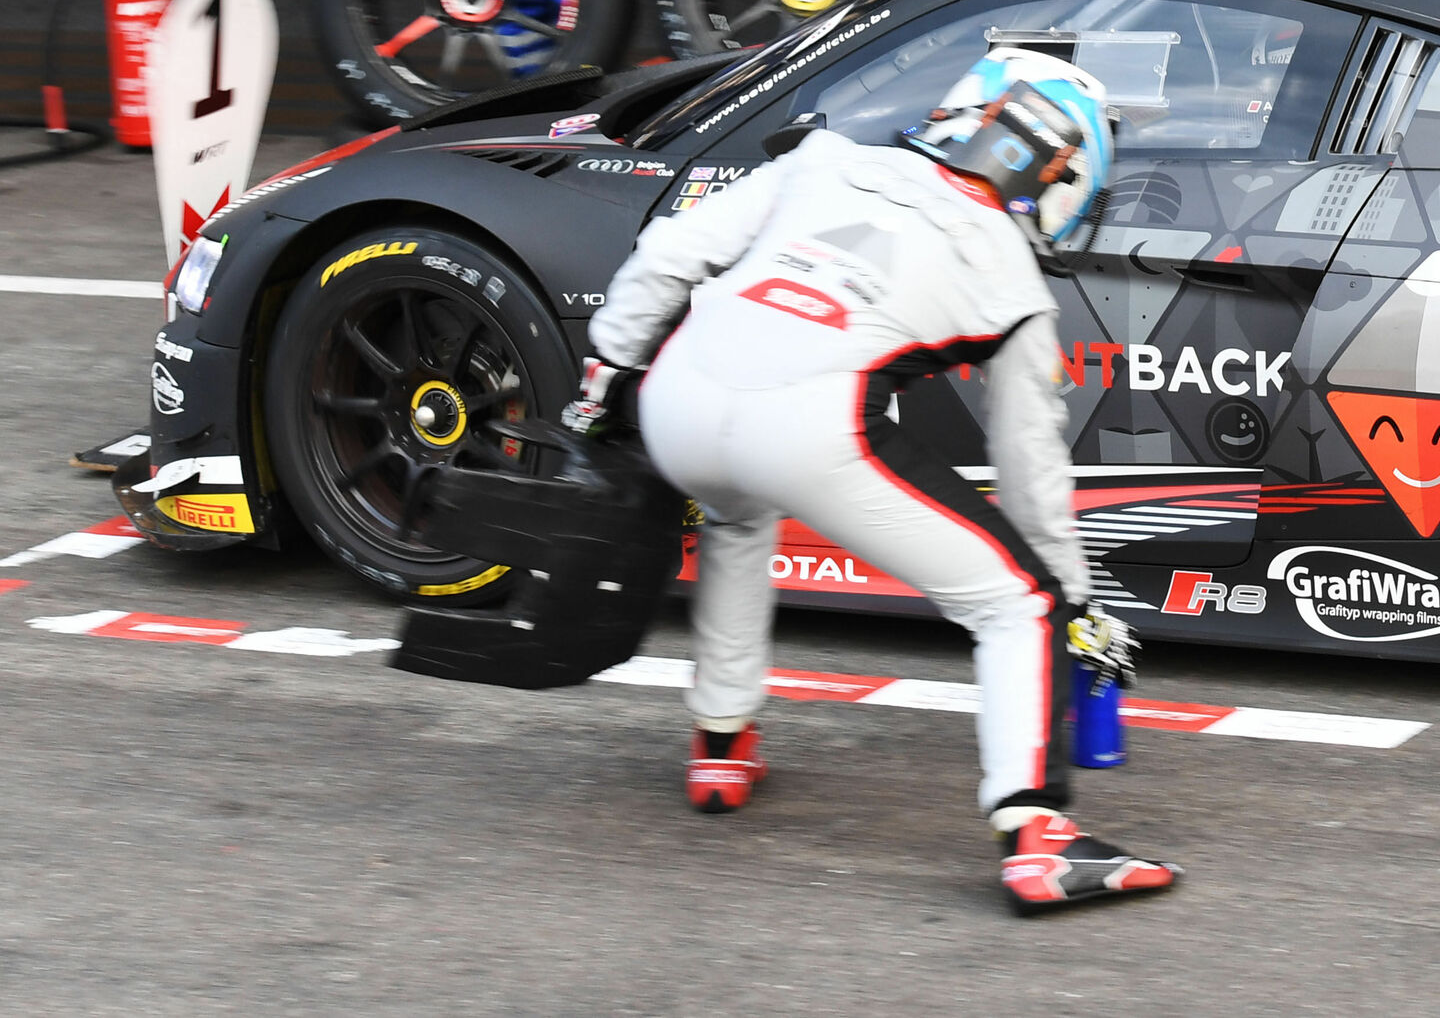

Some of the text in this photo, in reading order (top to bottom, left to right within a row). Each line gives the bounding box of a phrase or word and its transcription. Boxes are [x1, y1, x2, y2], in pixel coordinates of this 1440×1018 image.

[696, 9, 891, 133] www.belgianaudiclub.be
[175, 497, 236, 528] PIRELLI
[769, 554, 868, 583] OTAL
[1188, 582, 1267, 614] R8
[1317, 602, 1361, 620] Grafityp
[1363, 608, 1414, 625] wrapping
